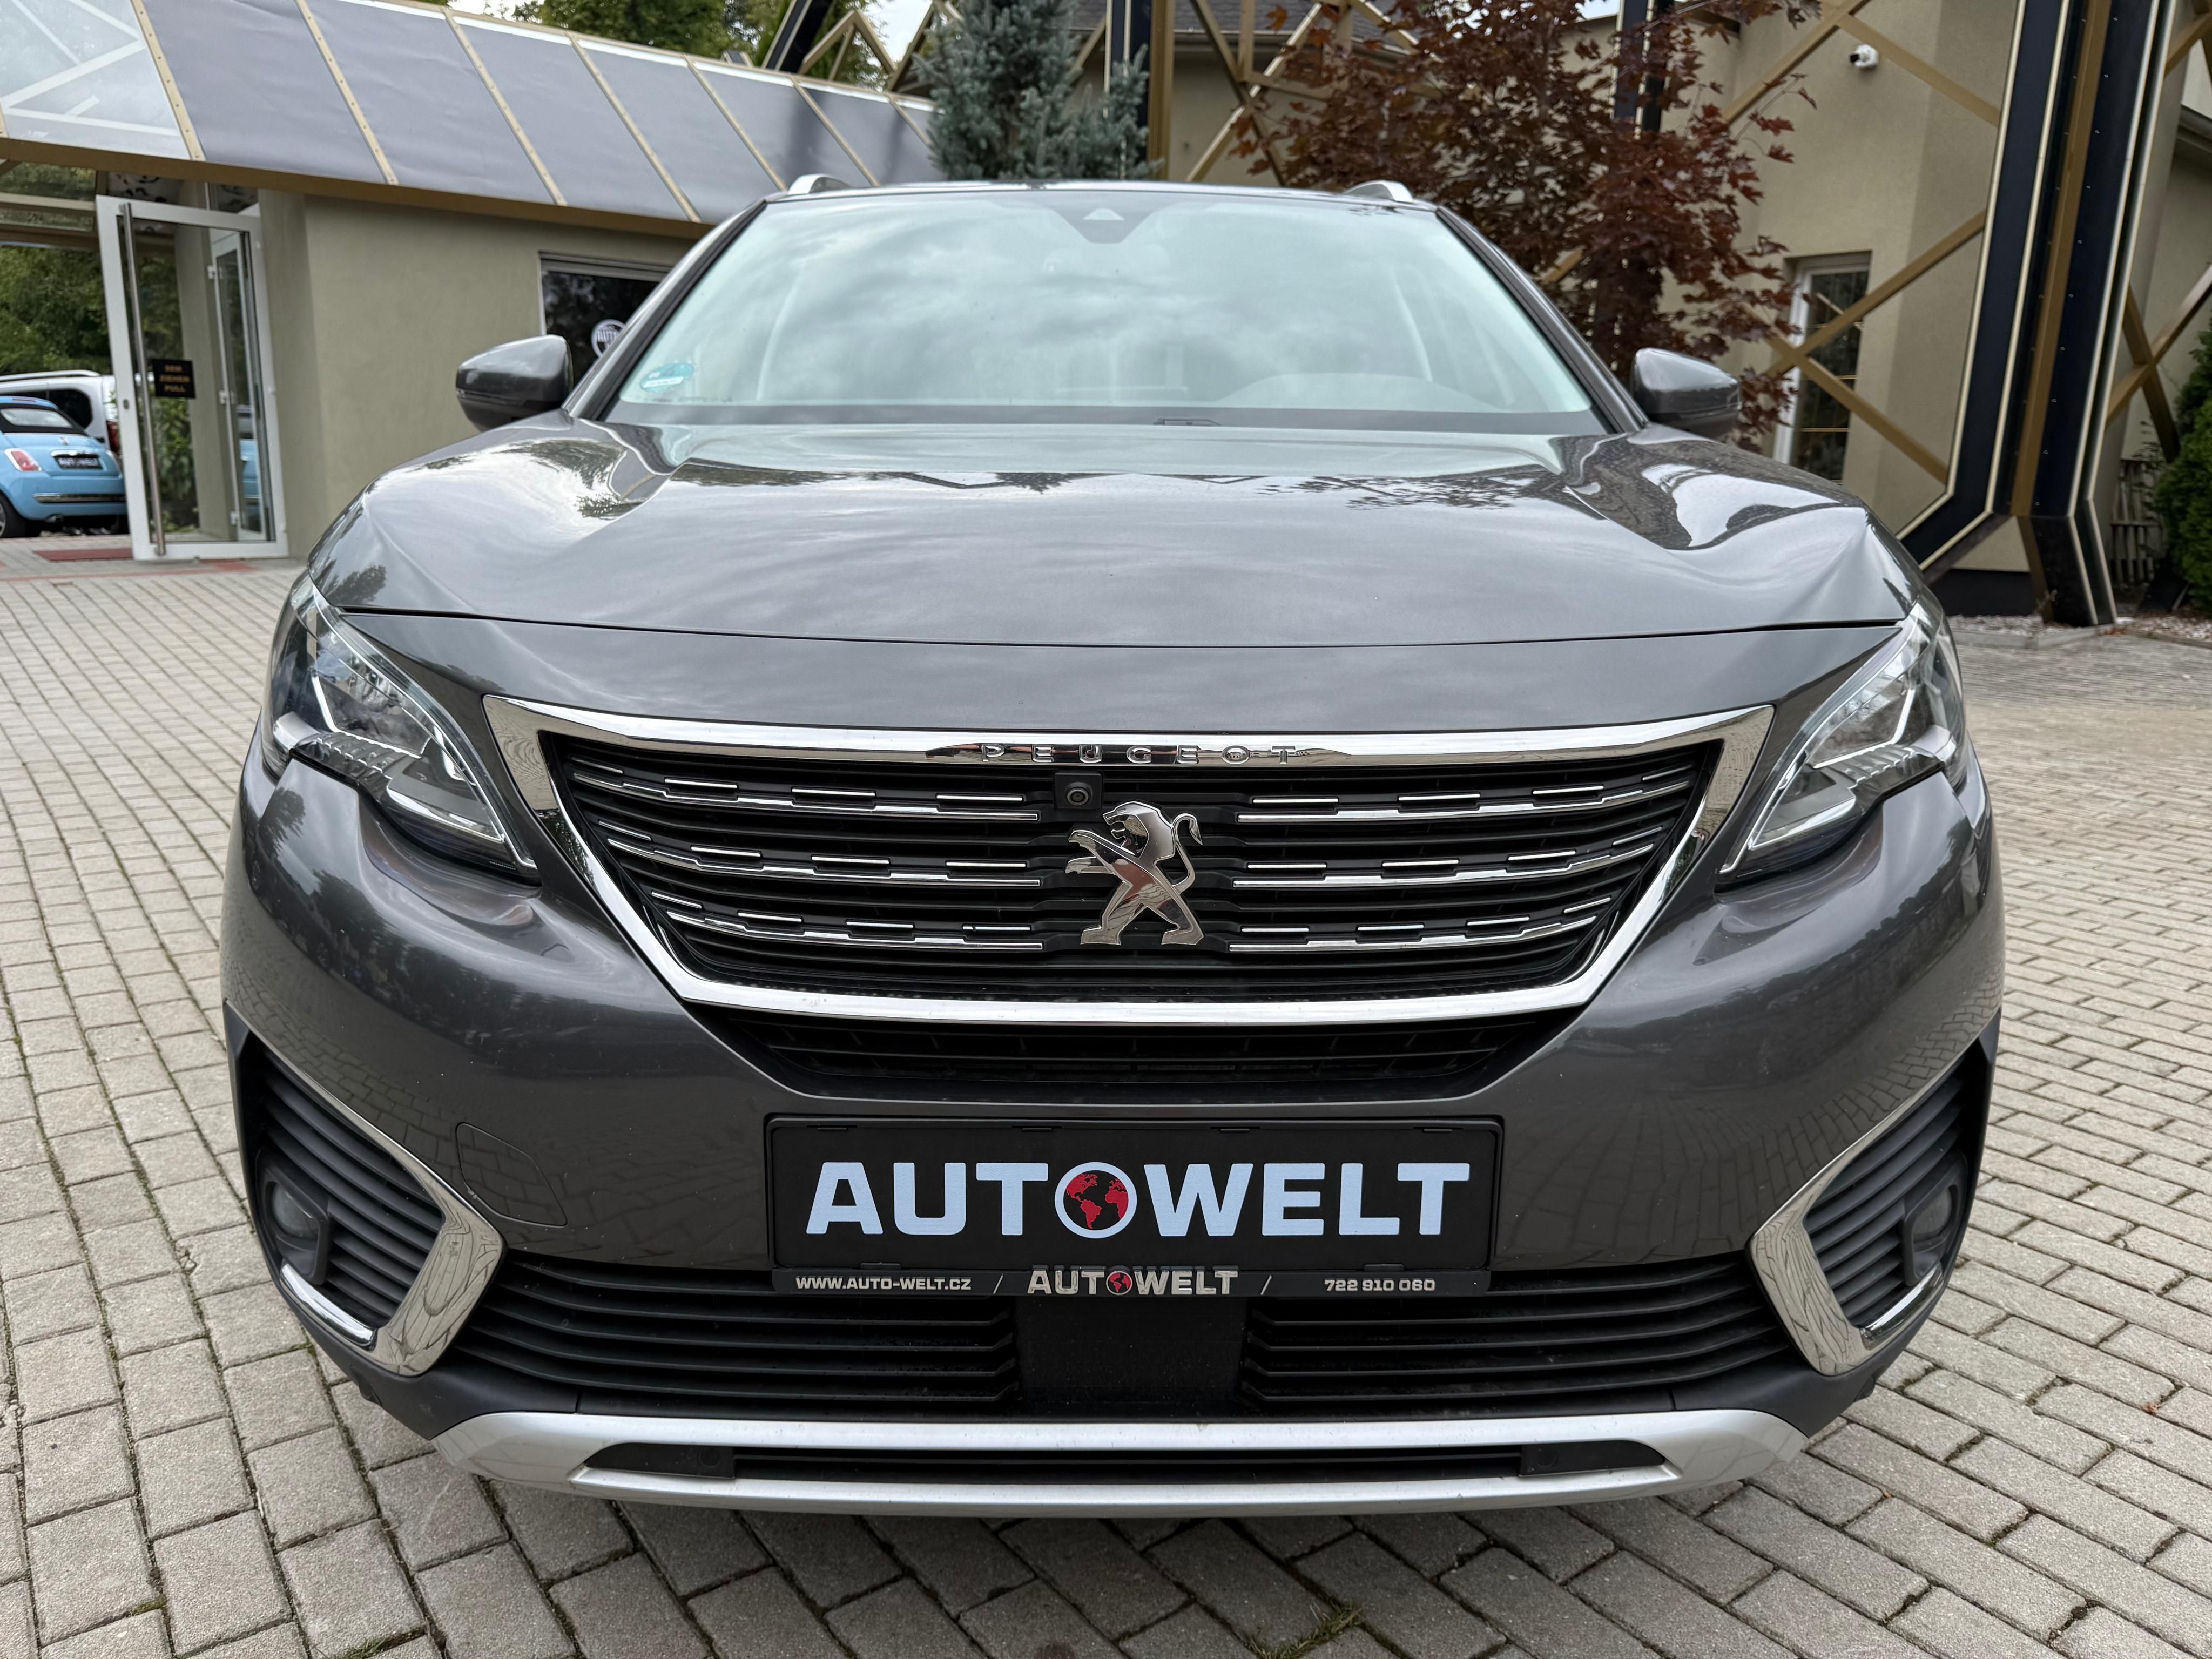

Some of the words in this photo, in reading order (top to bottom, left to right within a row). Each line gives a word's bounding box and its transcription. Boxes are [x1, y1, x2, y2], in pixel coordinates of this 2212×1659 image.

[982, 744, 1296, 764] PEUGEOT
[806, 1162, 1470, 1238] AUTOWELT
[795, 1277, 972, 1290] WWW.AUTO-WELT.CZ
[1027, 1269, 1238, 1295] AUTOWELT
[1324, 1279, 1358, 1291] 722
[1361, 1279, 1395, 1291] 910
[1398, 1279, 1435, 1291] 060
